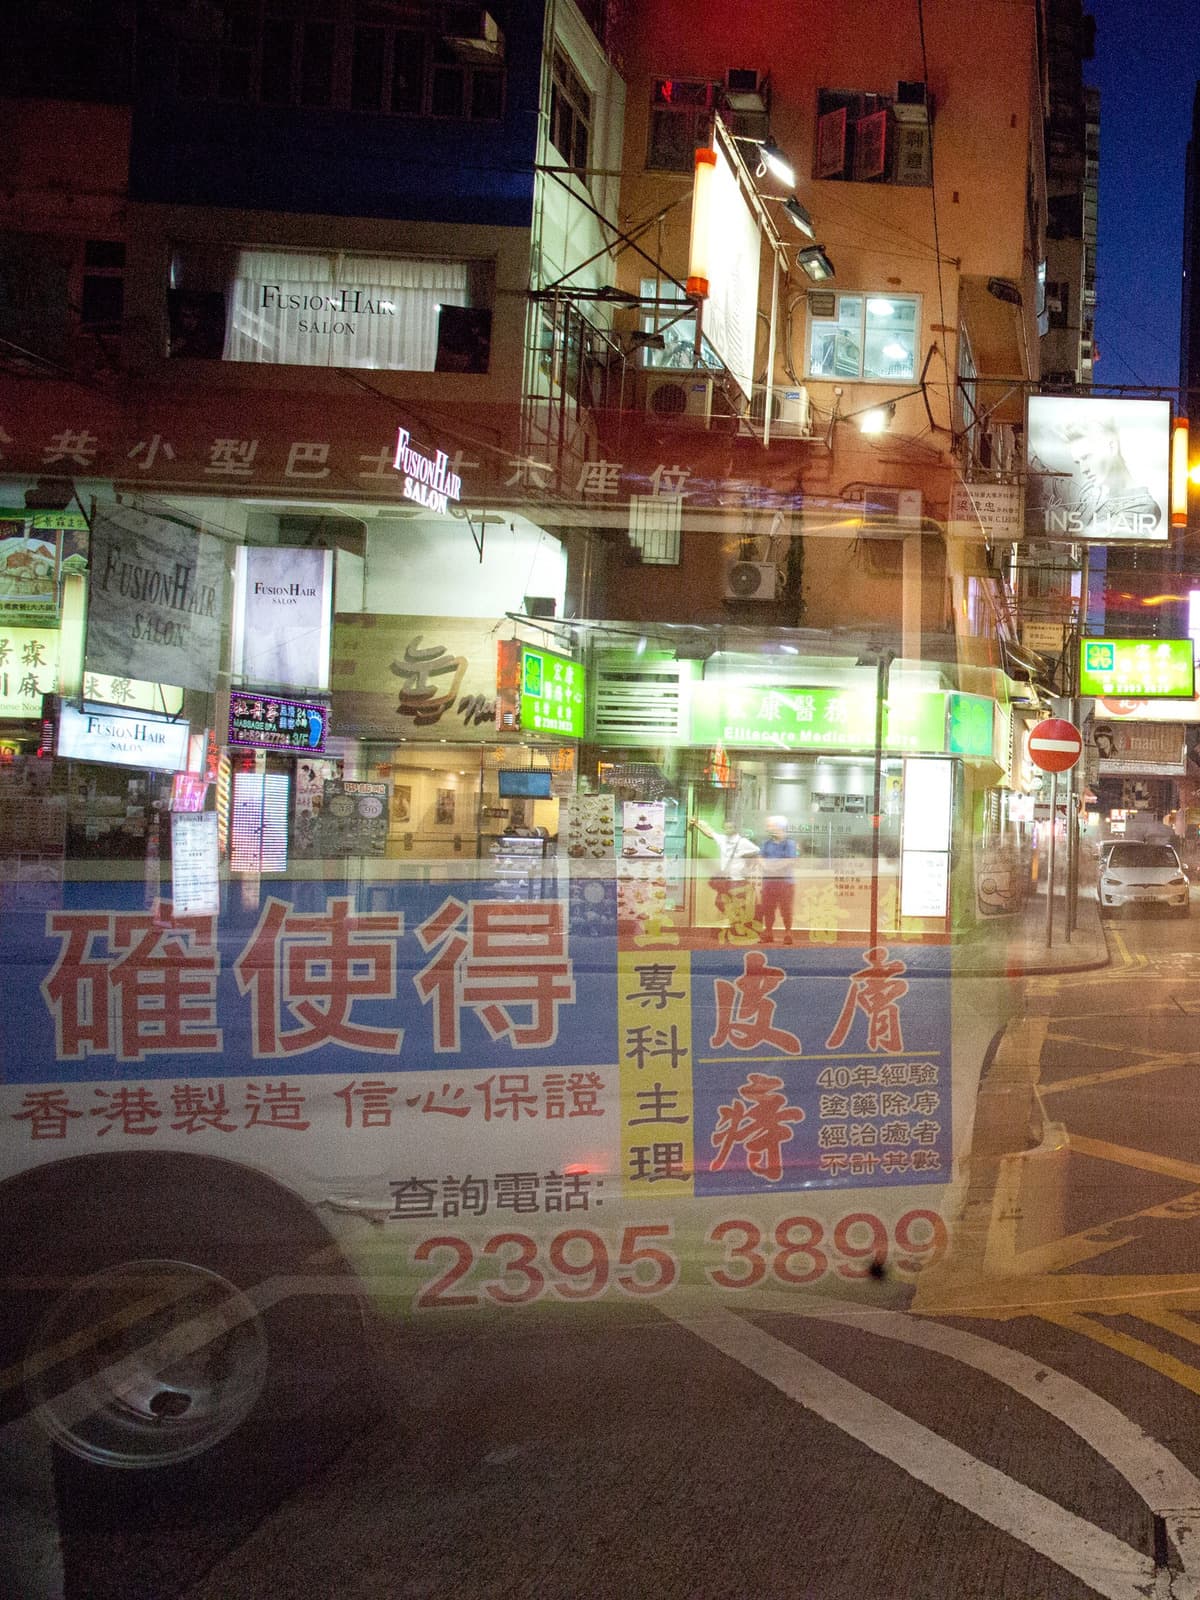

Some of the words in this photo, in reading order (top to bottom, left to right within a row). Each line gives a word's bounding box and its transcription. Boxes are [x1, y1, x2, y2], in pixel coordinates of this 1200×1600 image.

[298, 320, 357, 335] SALON
[403, 476, 448, 515] SALON
[1045, 510, 1084, 532] INS
[1093, 512, 1158, 534] HAIR
[132, 612, 186, 648] SALON
[111, 743, 143, 753] SALON
[39, 894, 577, 1063] 確使得
[709, 947, 910, 1056] 皮膚
[625, 962, 692, 1185] 專科主理
[817, 1062, 939, 1088] 40年經驗
[11, 1081, 312, 1141] 香港製造
[334, 1070, 606, 1129] 信心保證
[819, 1150, 941, 1176] 不計其數
[411, 1219, 680, 1312] 2395
[707, 1206, 954, 1295] 3899
